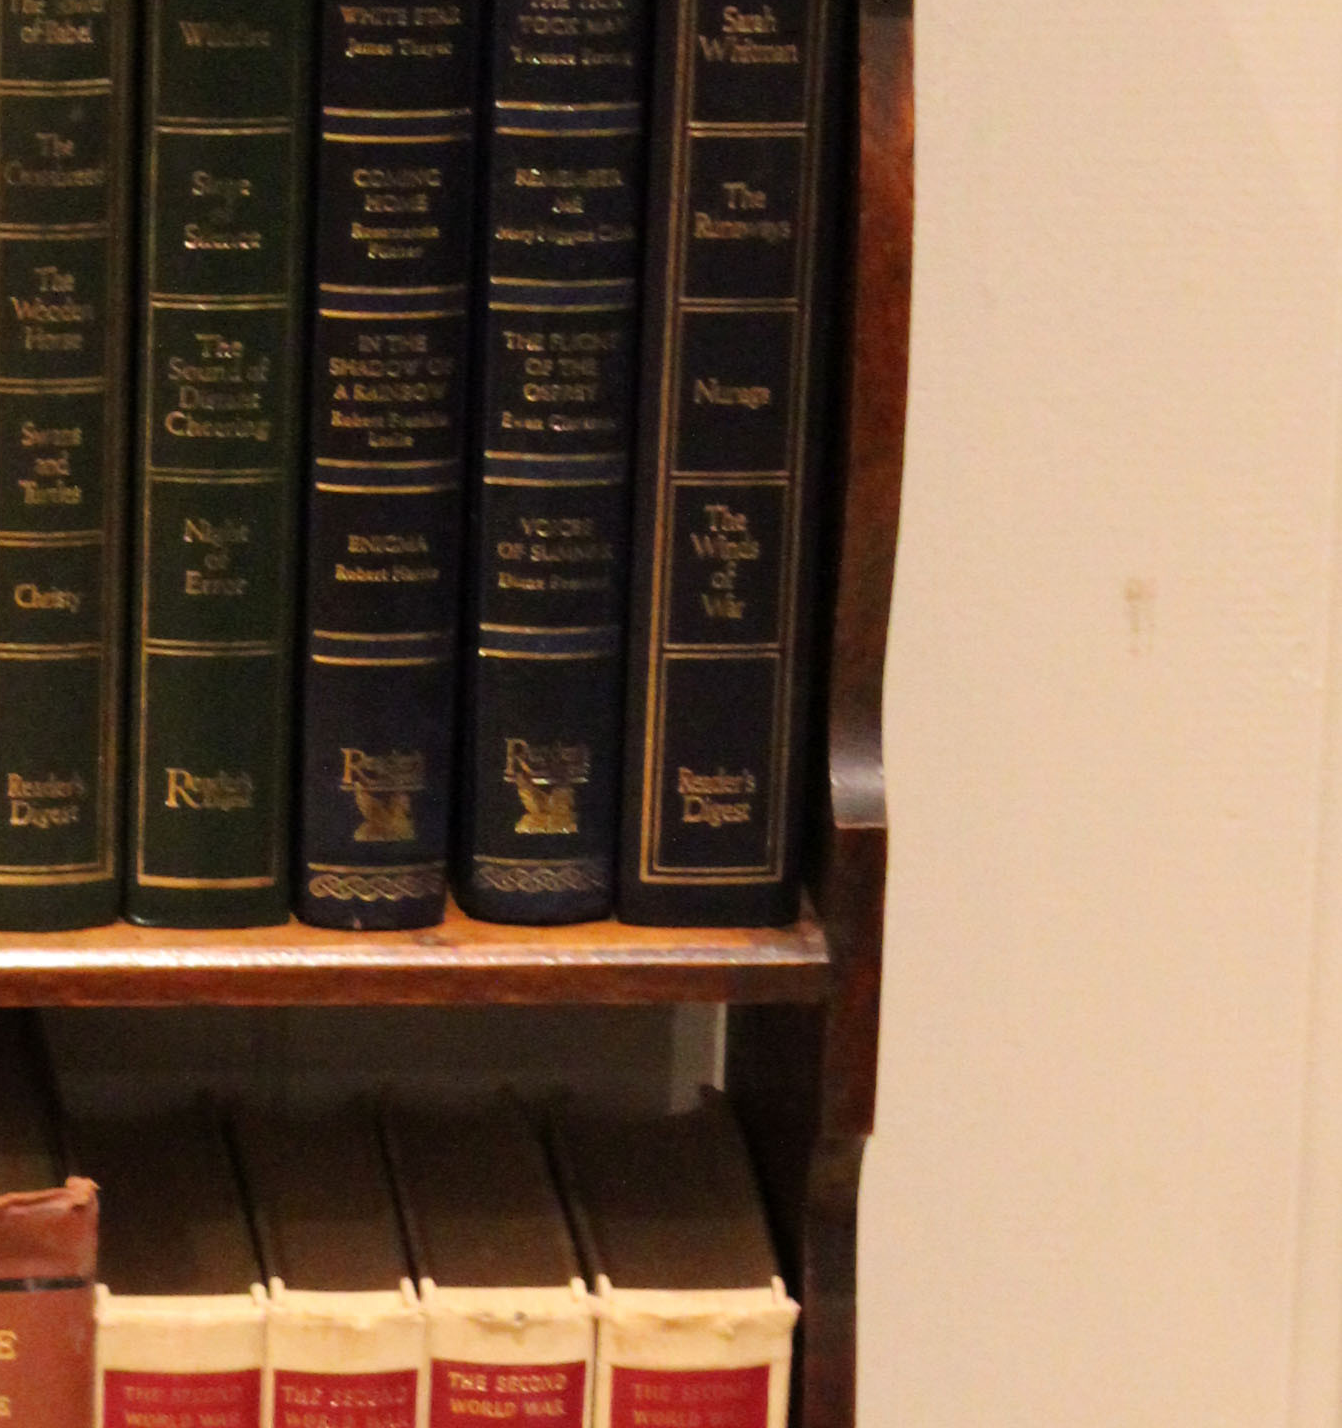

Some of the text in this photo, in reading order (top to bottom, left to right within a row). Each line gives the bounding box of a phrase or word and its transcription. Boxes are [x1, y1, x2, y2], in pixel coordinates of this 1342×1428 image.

[448, 1372, 568, 1393] THE SECOND
[450, 1399, 567, 1418] WORLD WAR
